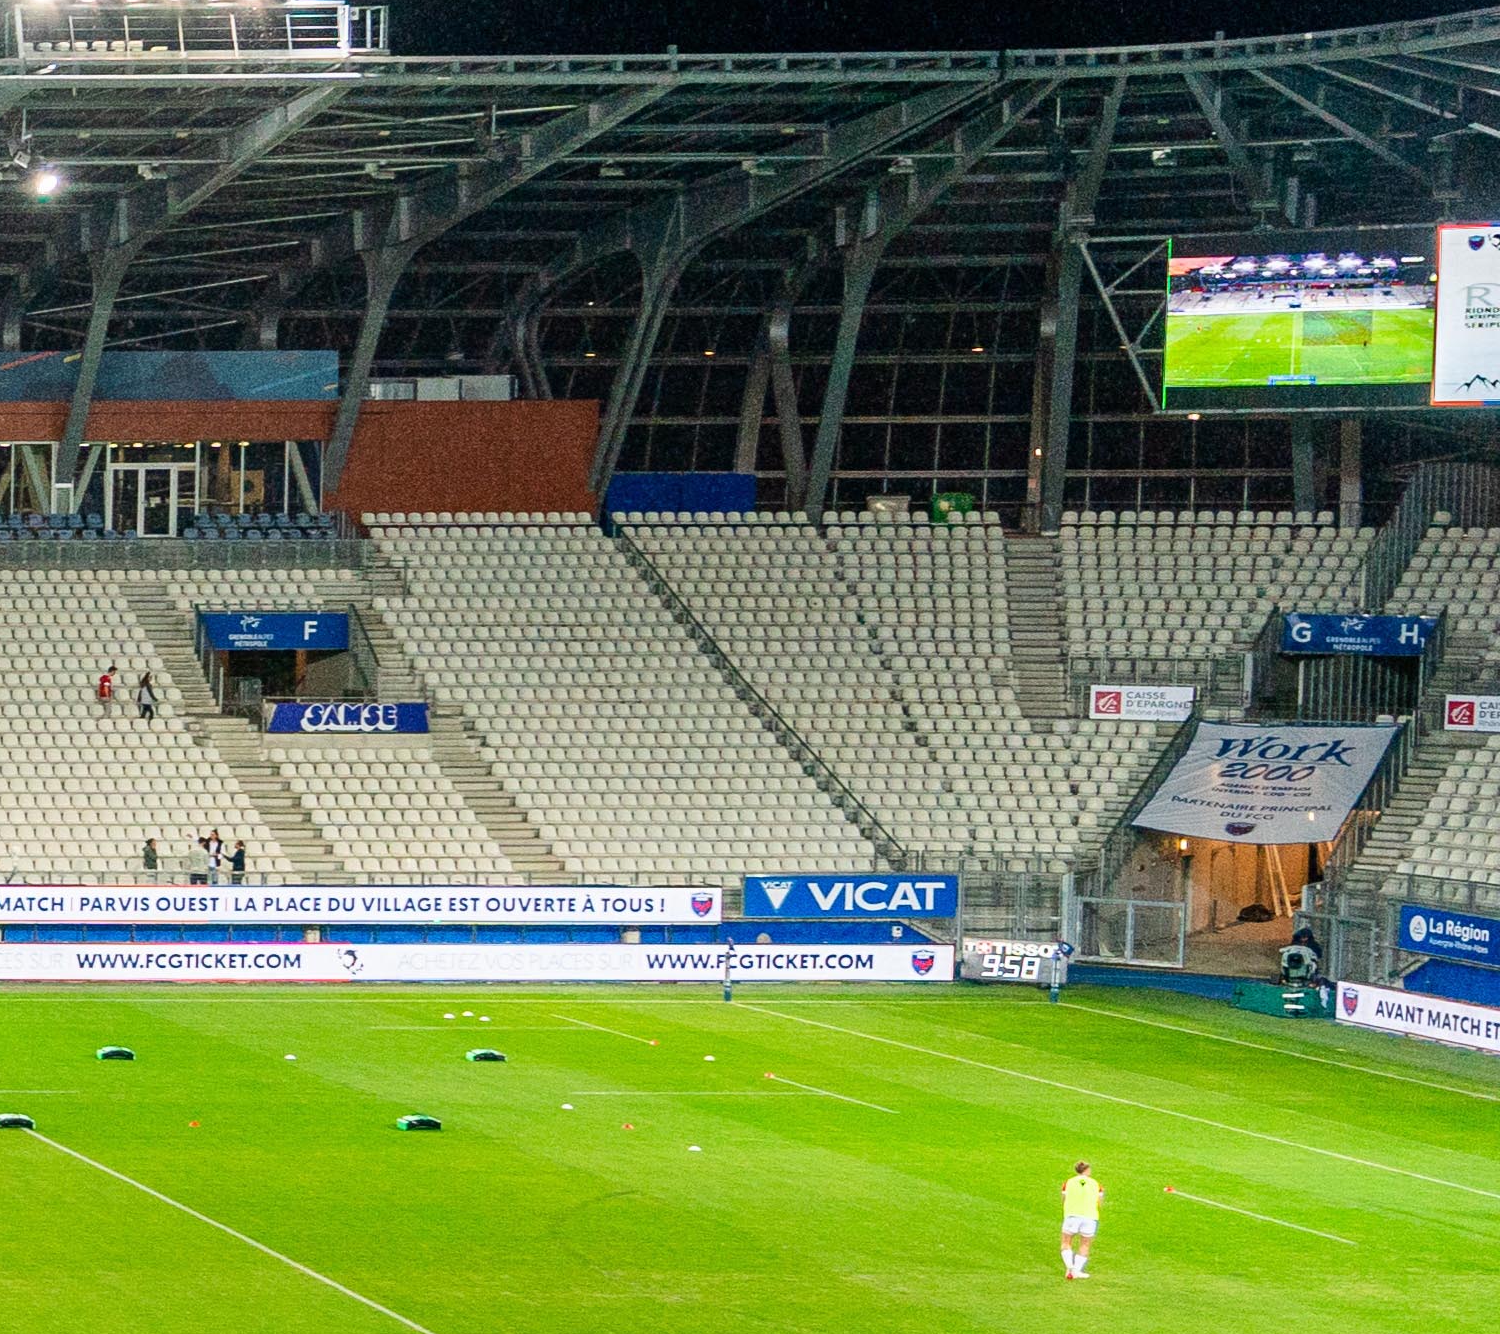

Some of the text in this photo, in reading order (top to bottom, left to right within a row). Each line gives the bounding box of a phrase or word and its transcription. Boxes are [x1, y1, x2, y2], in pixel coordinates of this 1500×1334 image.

[304, 620, 318, 640] F
[1291, 622, 1312, 643] G
[1126, 691, 1166, 700] CAISSE
[300, 703, 397, 732] SAMSE
[1216, 736, 1356, 767] Work
[1217, 762, 1316, 782] 2000
[1171, 795, 1332, 812] PARTENAIRE PRINCIPAL
[79, 897, 150, 912] PARVIS
[155, 897, 220, 912] OUEST
[234, 897, 257, 912] LA
[263, 897, 321, 912] PLACE
[328, 897, 355, 912] DU
[361, 897, 442, 912] VILLAGE
[449, 897, 480, 912] EST
[485, 897, 576, 912] OUVERTE
[582, 894, 595, 913] À
[601, 898, 654, 913] TOUS
[807, 882, 946, 911] VICAT
[1429, 917, 1490, 943] La Région
[76, 953, 301, 969] WWW.FCGTICKET.COM
[981, 954, 1041, 979] 9:58
[1375, 1000, 1500, 1040] AVANT MATCH ET
